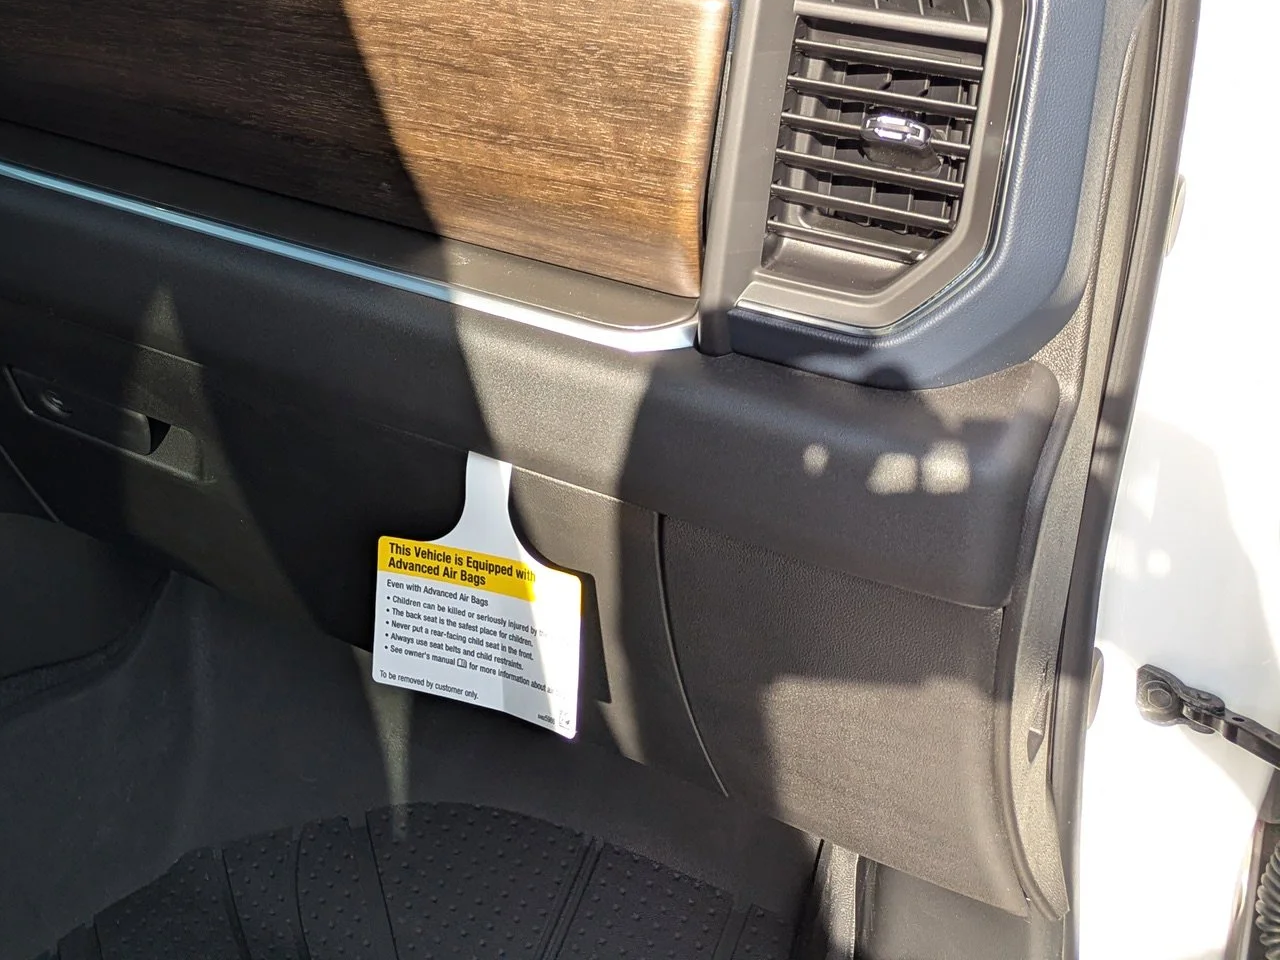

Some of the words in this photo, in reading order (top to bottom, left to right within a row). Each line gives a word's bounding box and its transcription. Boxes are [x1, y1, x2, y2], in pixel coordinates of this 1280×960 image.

[388, 557, 439, 576] Advanced
[443, 567, 457, 579] Air
[461, 570, 486, 586] Bags
[389, 542, 411, 556] This
[414, 546, 451, 564] Vehicle
[455, 554, 463, 565] is
[467, 556, 512, 576] Equipped
[516, 569, 535, 582] with
[387, 579, 404, 589] Even
[406, 583, 421, 592] with
[423, 586, 457, 599] Advanced
[460, 593, 469, 602] Air
[471, 595, 488, 607] Bags
[392, 608, 404, 616] The
[406, 610, 421, 620] back
[423, 615, 437, 623] seat
[439, 617, 444, 625] is
[446, 619, 456, 627] the
[458, 622, 478, 632] safest
[480, 627, 497, 636] place
[499, 630, 507, 639] for
[509, 634, 533, 647] children.
[393, 596, 420, 607] Children
[423, 602, 435, 610] can
[438, 604, 445, 612] be
[448, 606, 466, 616] killed
[468, 611, 475, 619] or
[477, 613, 506, 627] seriously
[508, 620, 529, 632] injured
[531, 626, 537, 636] by
[391, 633, 414, 644] Always
[429, 641, 443, 650] seat
[445, 644, 461, 654] belts
[463, 649, 475, 657] and
[477, 651, 492, 661] child
[494, 656, 523, 670] restraints.
[392, 620, 410, 630] Never
[431, 629, 466, 644] rear-facing
[468, 637, 483, 646] child
[485, 641, 499, 650] seat
[501, 643, 506, 652] in
[508, 646, 517, 655] the
[519, 649, 534, 660] front.
[380, 670, 387, 678] To
[389, 672, 396, 680] be
[398, 675, 425, 686] removed
[426, 679, 434, 689] by
[435, 683, 463, 695] customer
[465, 689, 479, 700] only.
[390, 645, 402, 654] See
[404, 649, 430, 660] owner's
[432, 654, 455, 665] manual
[469, 662, 478, 670] for
[480, 665, 496, 675] more
[498, 669, 530, 686] information
[531, 680, 546, 693] about
